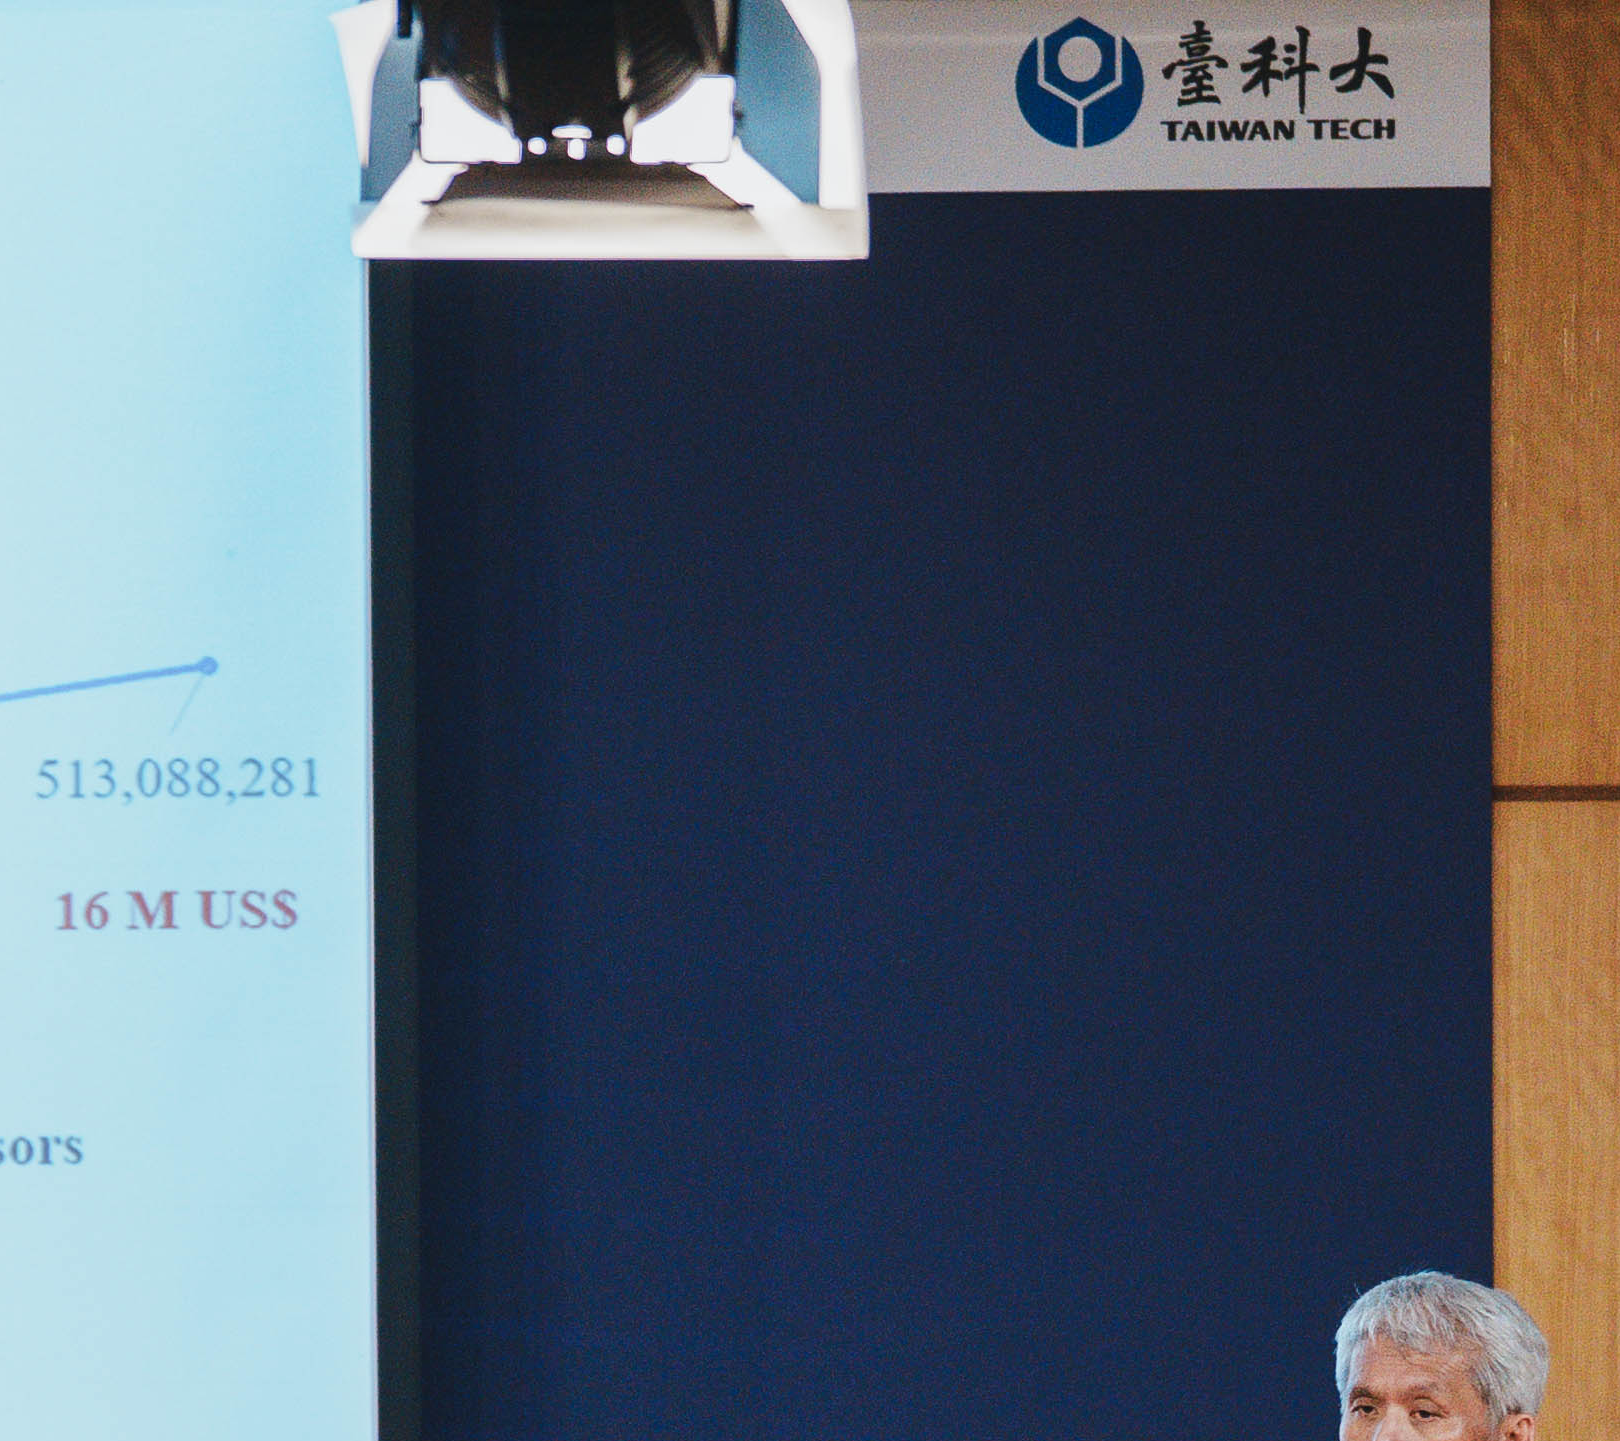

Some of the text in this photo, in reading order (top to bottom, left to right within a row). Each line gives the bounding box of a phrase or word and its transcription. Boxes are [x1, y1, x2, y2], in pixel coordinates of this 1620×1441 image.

[1162, 20, 1394, 114] 臺科大
[1161, 119, 1395, 141] TAIWAN TECH
[38, 757, 318, 802] 513,088,281
[58, 890, 297, 930] 16 M US$
